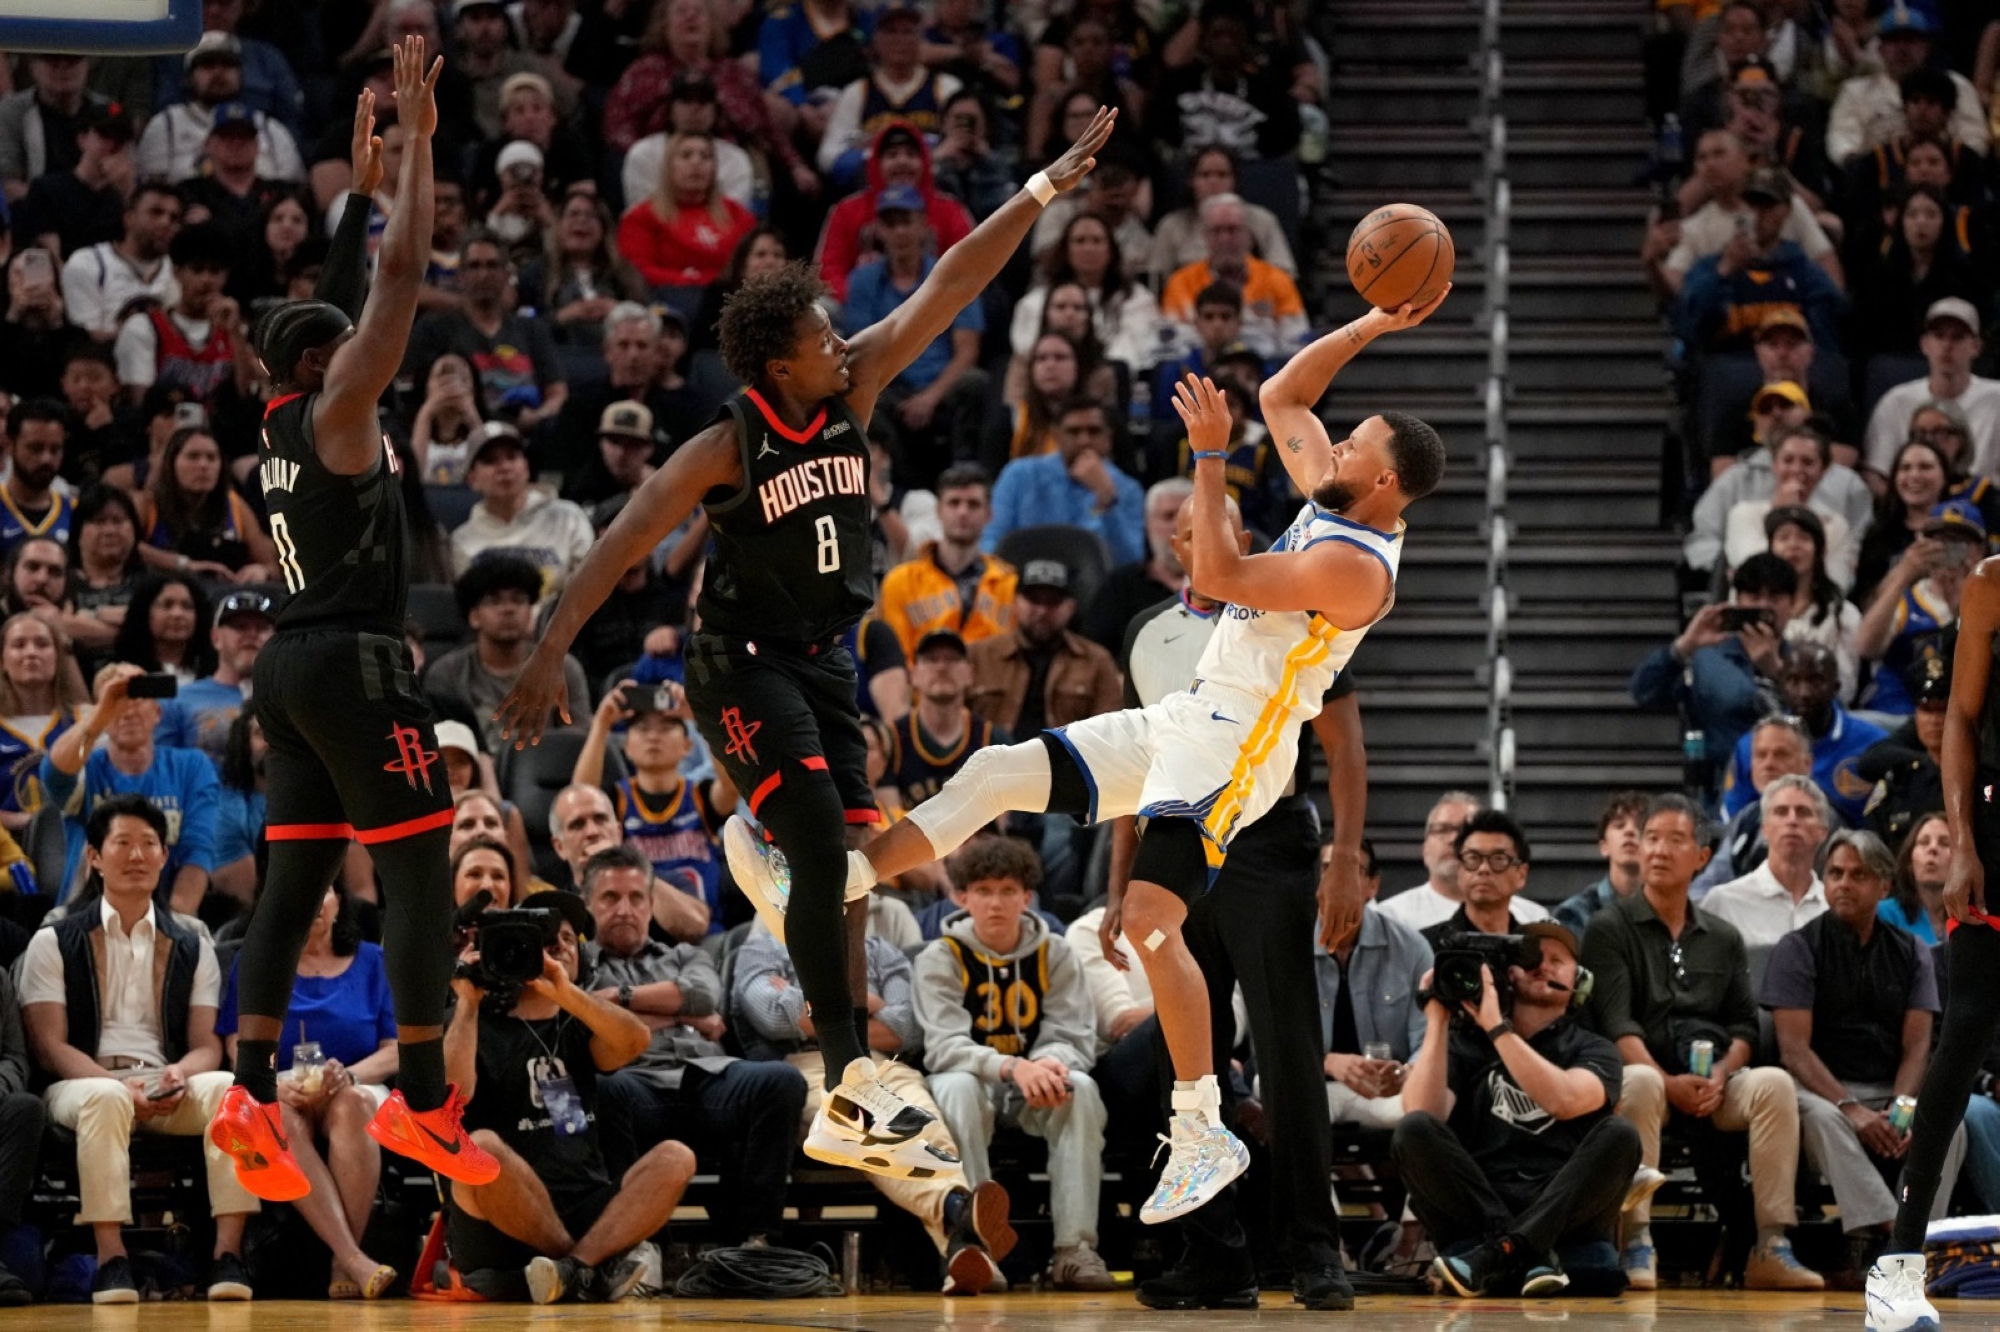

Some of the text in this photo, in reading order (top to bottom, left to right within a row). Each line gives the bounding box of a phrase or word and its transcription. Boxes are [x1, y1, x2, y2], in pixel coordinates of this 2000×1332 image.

[758, 455, 866, 525] HOUSTON
[269, 512, 306, 595] 0
[814, 514, 840, 574] 8
[976, 980, 1038, 1030] 30
